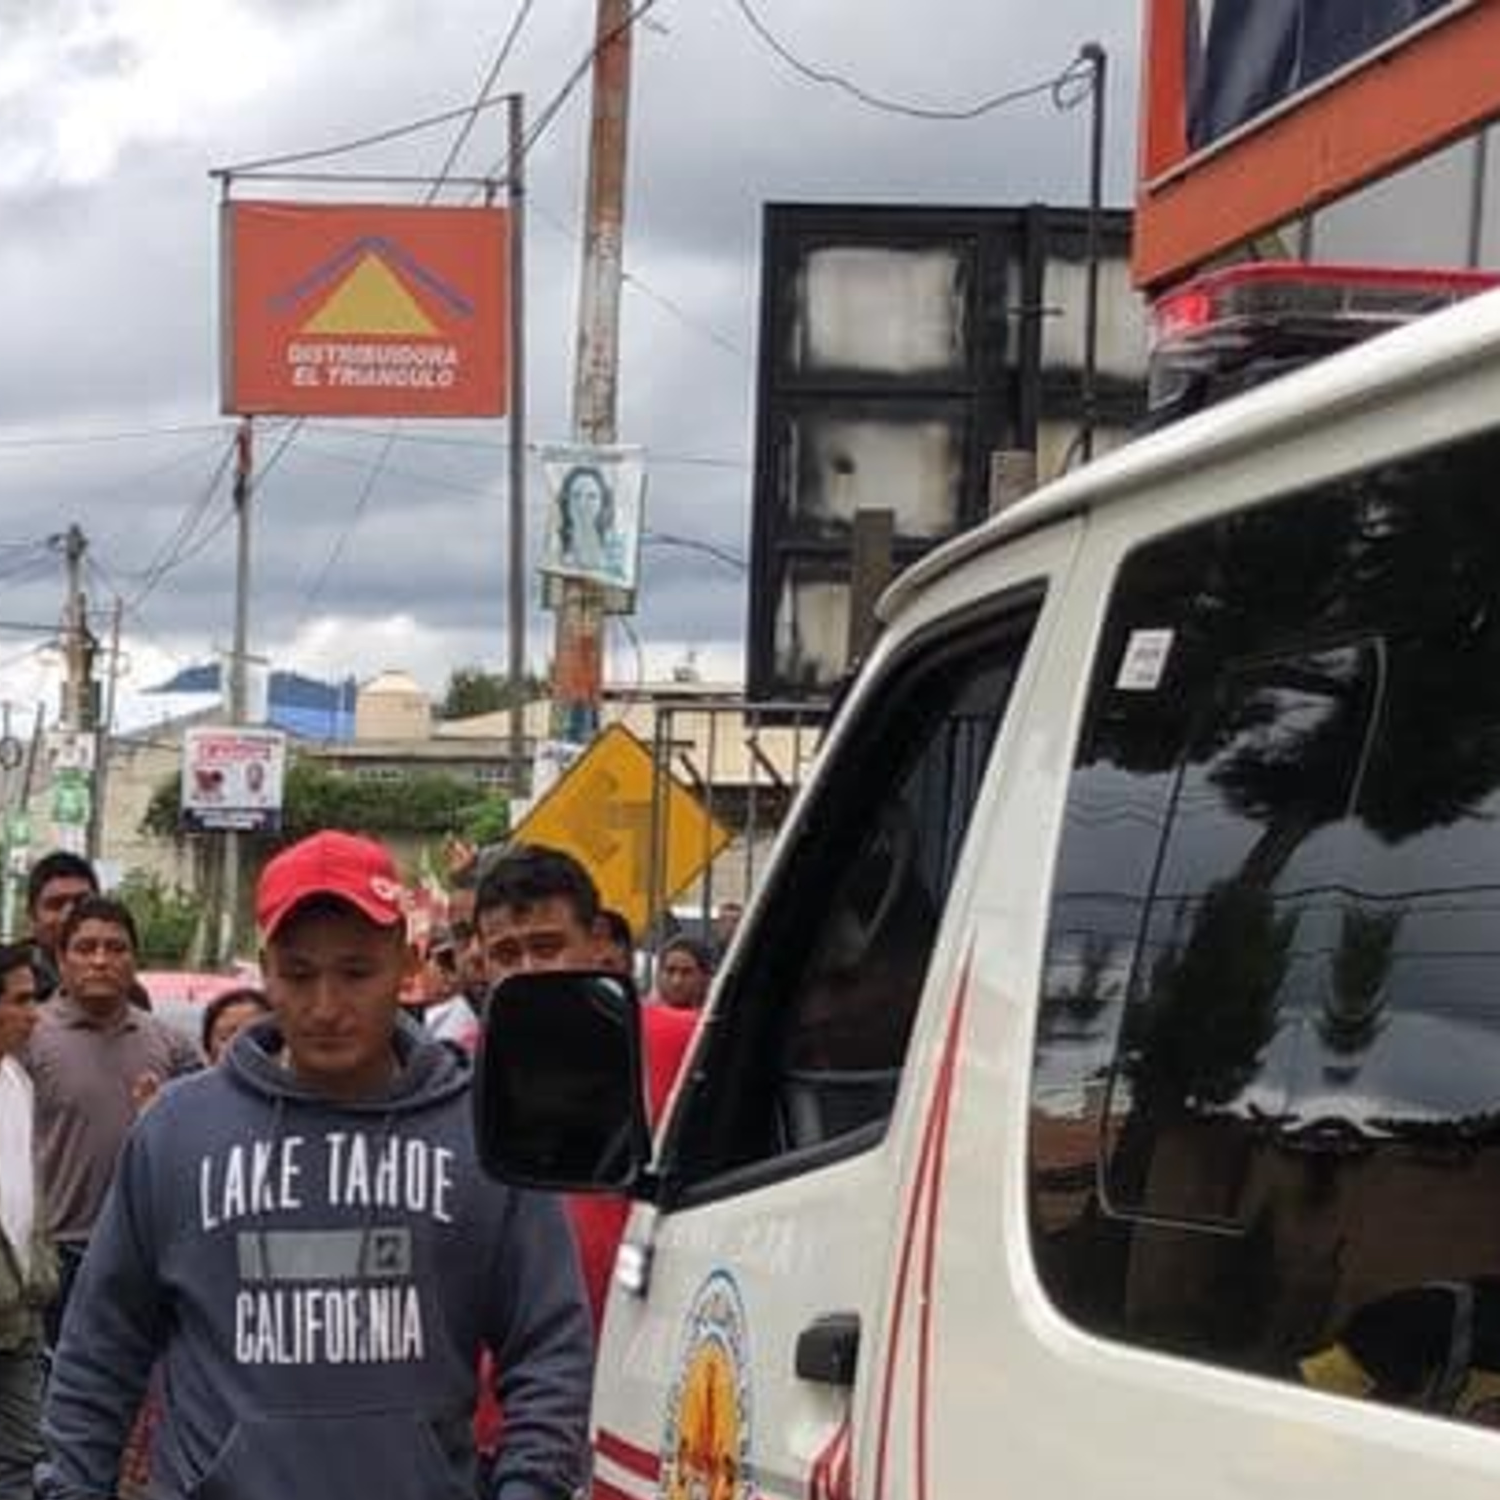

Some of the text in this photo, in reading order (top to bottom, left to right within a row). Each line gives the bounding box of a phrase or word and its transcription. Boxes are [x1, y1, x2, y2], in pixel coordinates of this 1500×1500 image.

[292, 365, 321, 387] EL
[202, 1132, 455, 1232] LAKE TAHOE
[235, 1286, 424, 1364] CALIFORNIA
